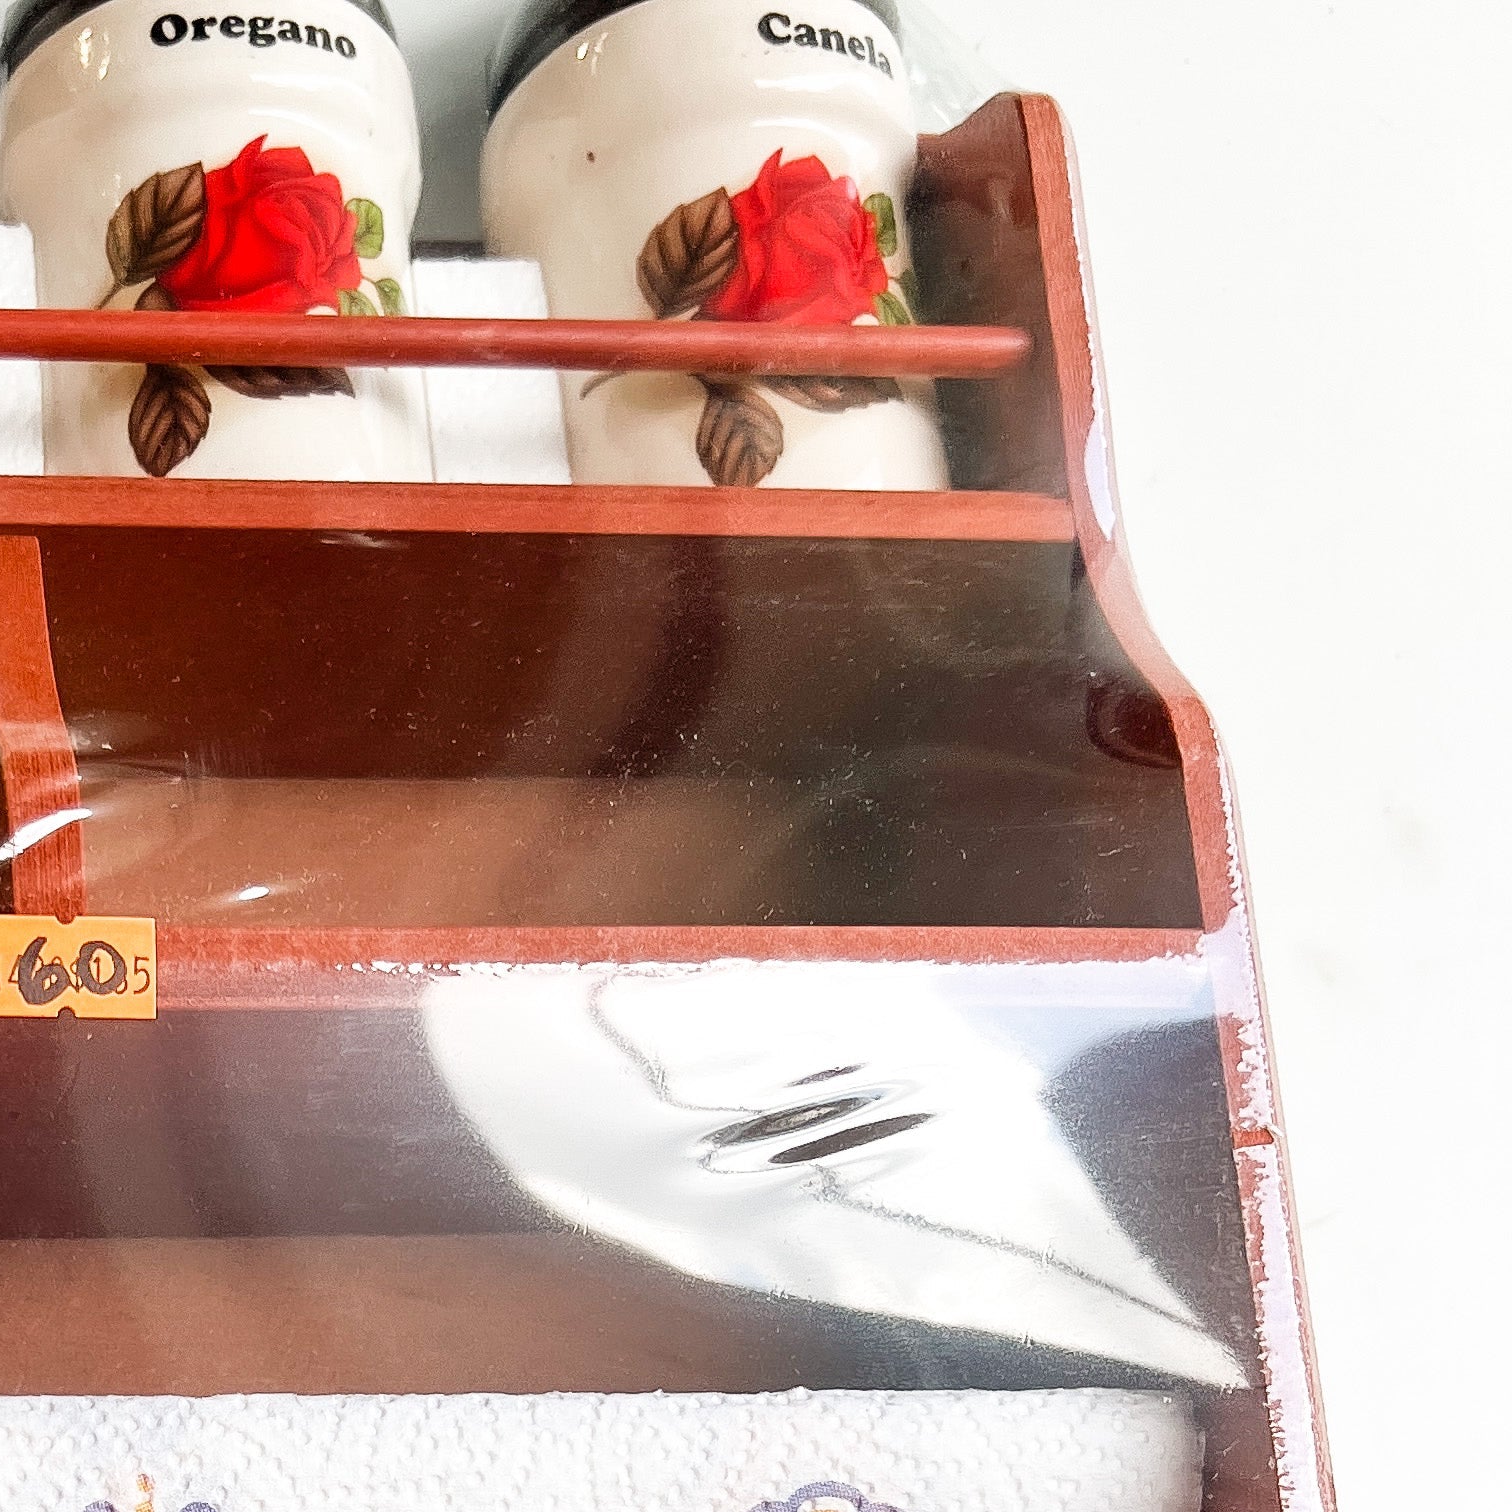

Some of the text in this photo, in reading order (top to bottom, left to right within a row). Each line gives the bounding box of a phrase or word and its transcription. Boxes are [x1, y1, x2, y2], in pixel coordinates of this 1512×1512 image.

[149, 13, 357, 59] Oregano
[757, 12, 893, 79] Canela
[18, 936, 128, 1006] 60
